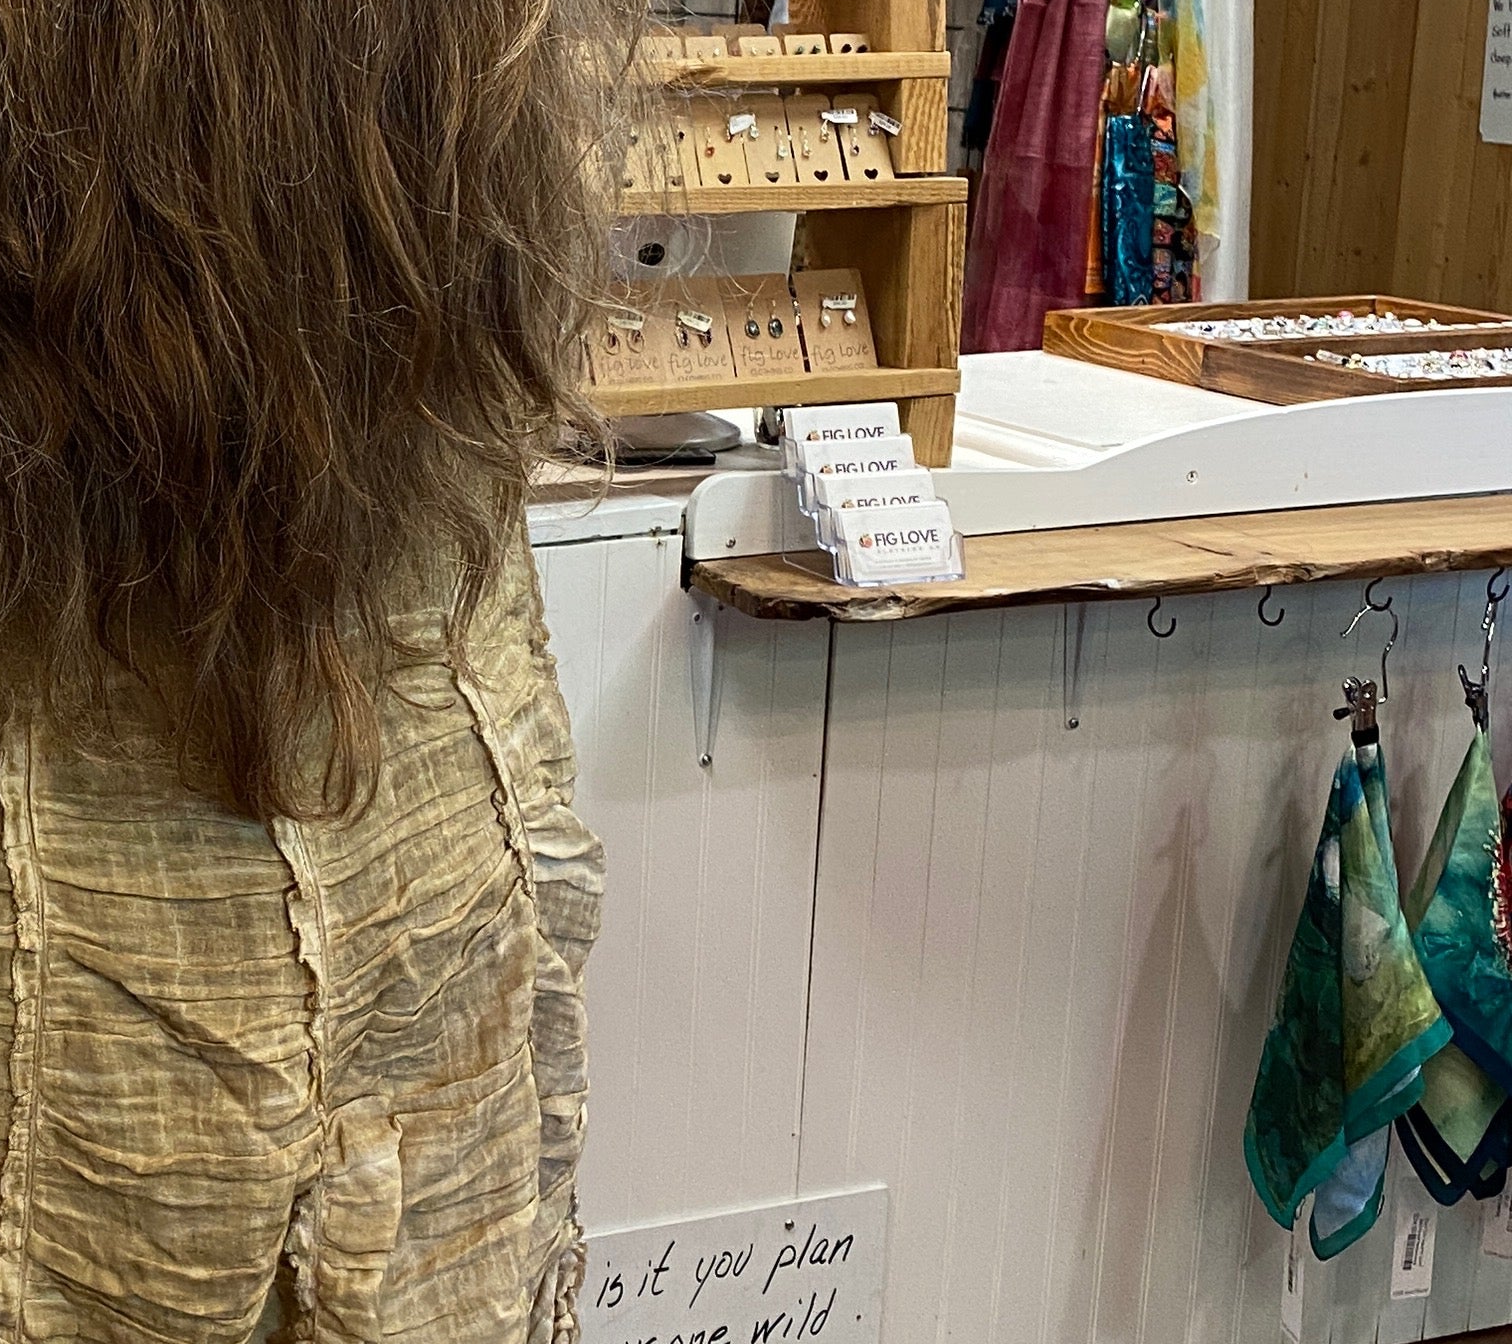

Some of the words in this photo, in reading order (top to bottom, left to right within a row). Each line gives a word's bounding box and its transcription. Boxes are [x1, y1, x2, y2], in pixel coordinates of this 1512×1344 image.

[822, 428, 845, 441] FIG
[874, 532, 898, 547] FIG
[899, 529, 940, 545] LOVE
[596, 1260, 624, 1308] is
[637, 1240, 676, 1298] it
[688, 1243, 754, 1309] you
[762, 1223, 854, 1295] plan
